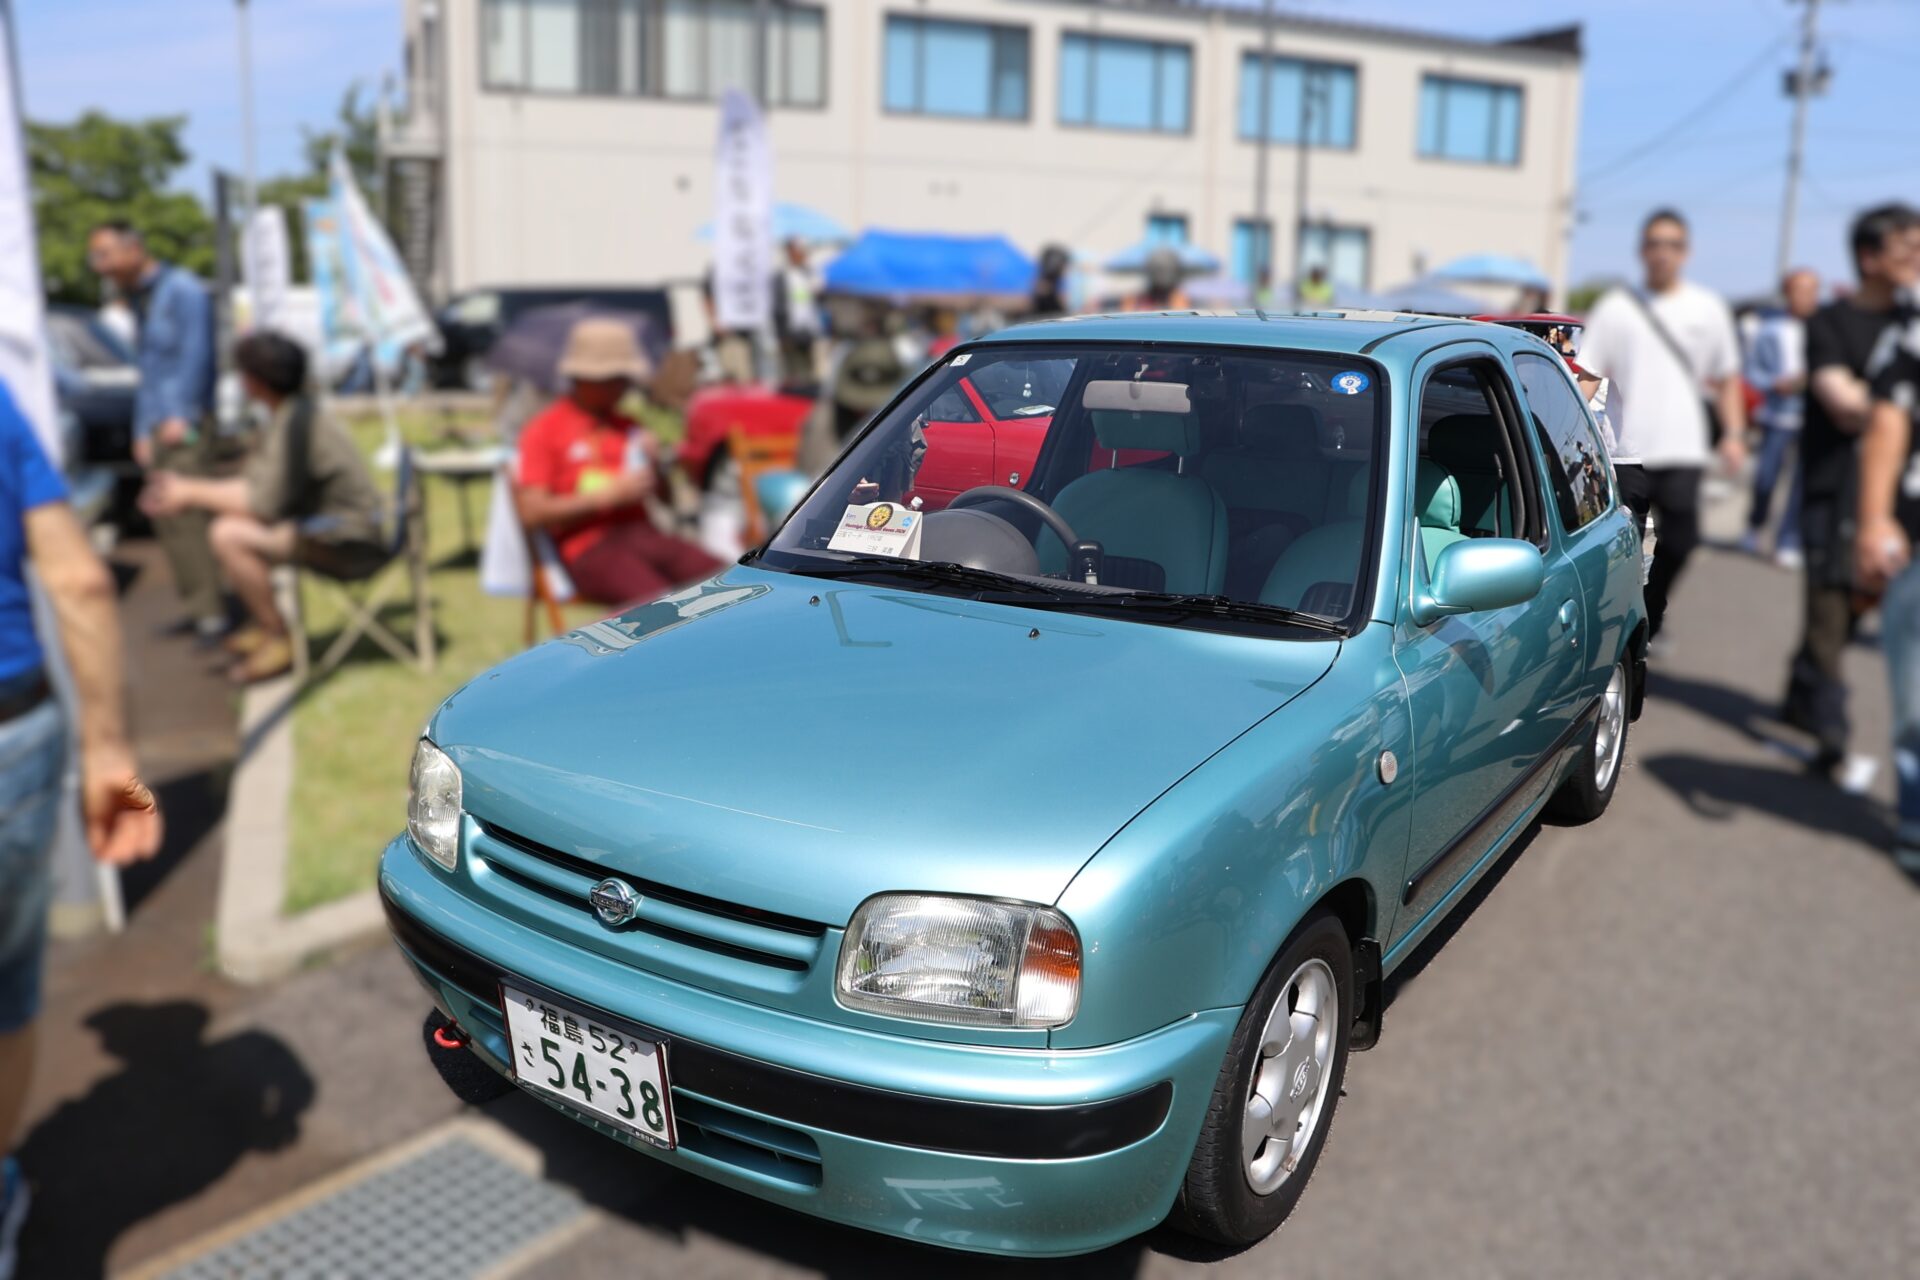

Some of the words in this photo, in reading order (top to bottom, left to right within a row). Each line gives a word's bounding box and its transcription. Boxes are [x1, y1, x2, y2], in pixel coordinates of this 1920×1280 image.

[540, 1005, 584, 1045] 福島
[589, 1023, 627, 1063] 52
[521, 1041, 535, 1068] さ
[541, 1036, 665, 1132] 54-38
